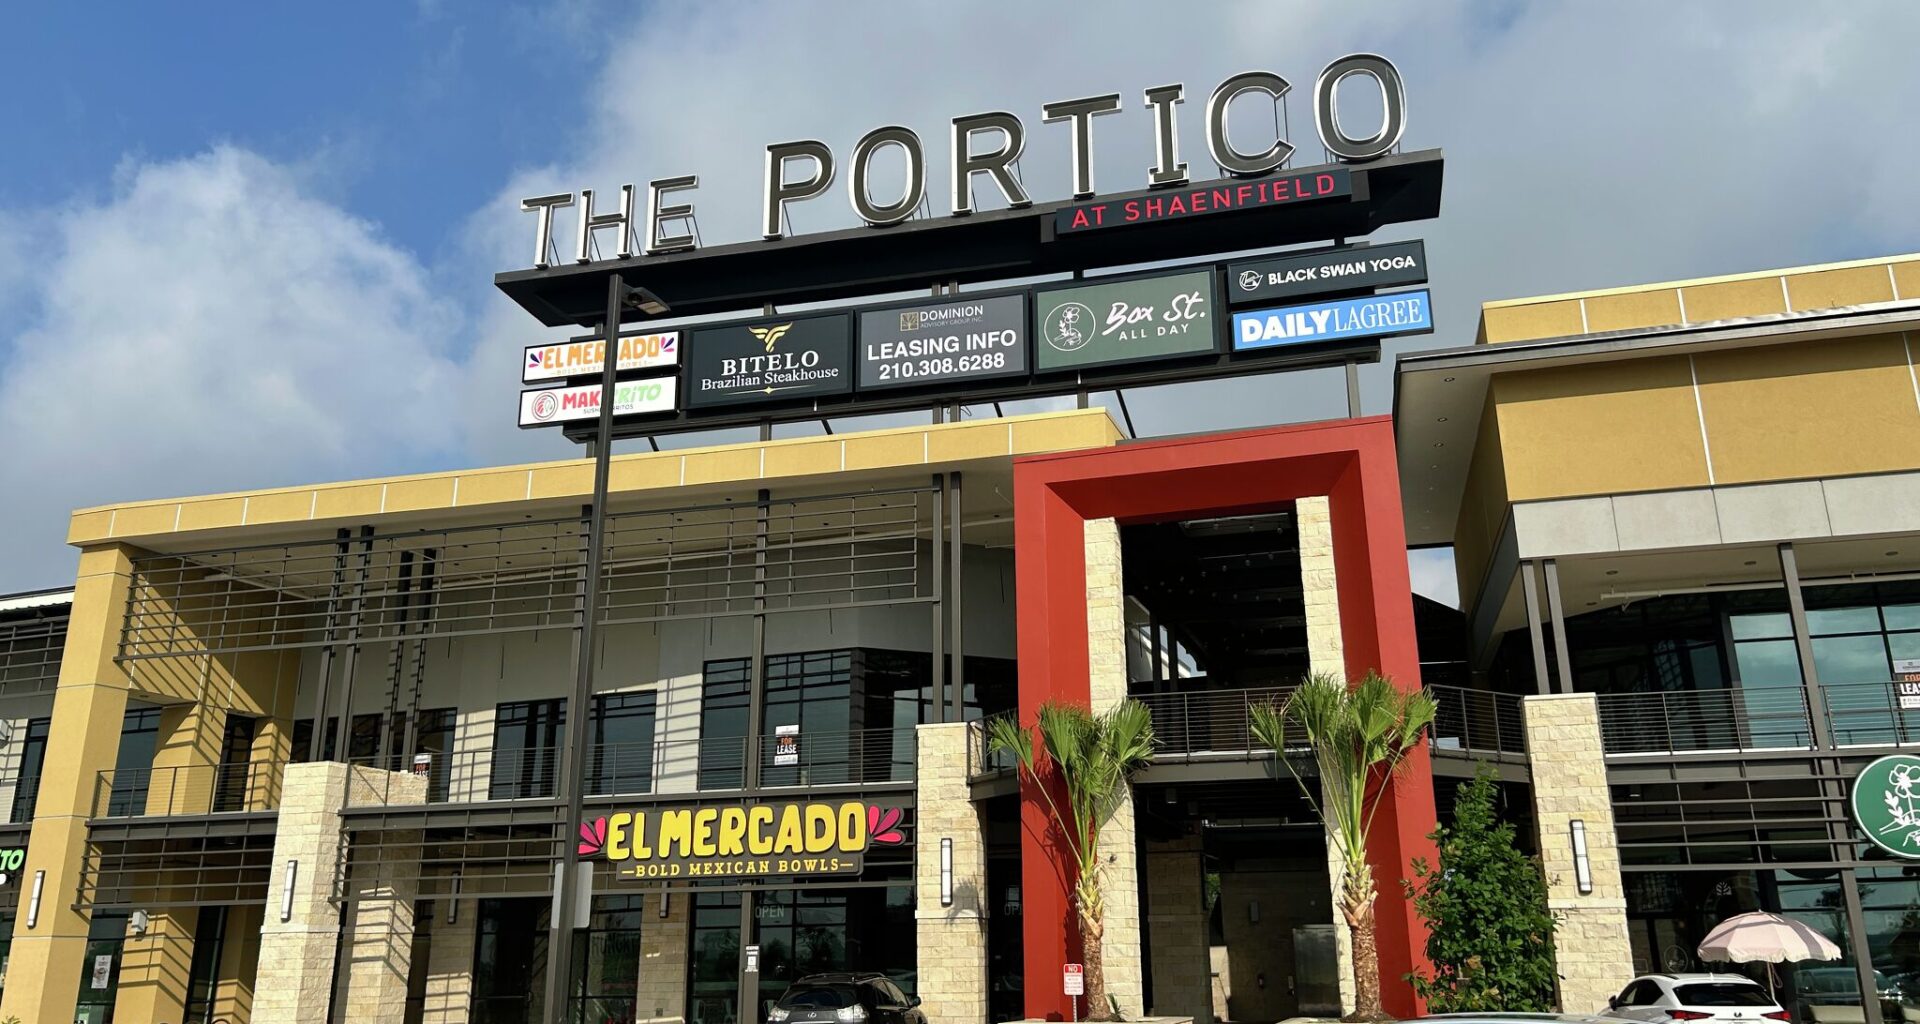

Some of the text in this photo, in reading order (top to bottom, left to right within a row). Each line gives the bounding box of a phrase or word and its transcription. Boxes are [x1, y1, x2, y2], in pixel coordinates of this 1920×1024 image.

[520, 52, 1408, 270] THE PORTICO
[1071, 174, 1336, 229] AT SHAENFIELD
[1268, 255, 1416, 285] BLACK SWAN YOGA
[920, 305, 983, 322] DOMINION
[1102, 290, 1206, 336] Box St.
[1240, 298, 1423, 343] DAILY LAGREE
[1118, 323, 1189, 341] ALL DAY
[544, 336, 660, 369] EL MERADO
[867, 329, 1017, 361] LEASING INFO
[722, 350, 819, 376] BITELO
[879, 353, 1005, 380] 210.308.6288
[701, 367, 839, 390] Brazilian Steakhouse
[583, 407, 601, 415] SUSH
[1900, 682, 1920, 694] LEA
[777, 744, 797, 755] LEASE
[781, 737, 792, 745] FOR
[606, 802, 867, 860] EL MERCADO
[0, 849, 24, 871] TO
[636, 858, 839, 878] BOLD MEXICAN BOWLS
[755, 905, 785, 918] OPEN
